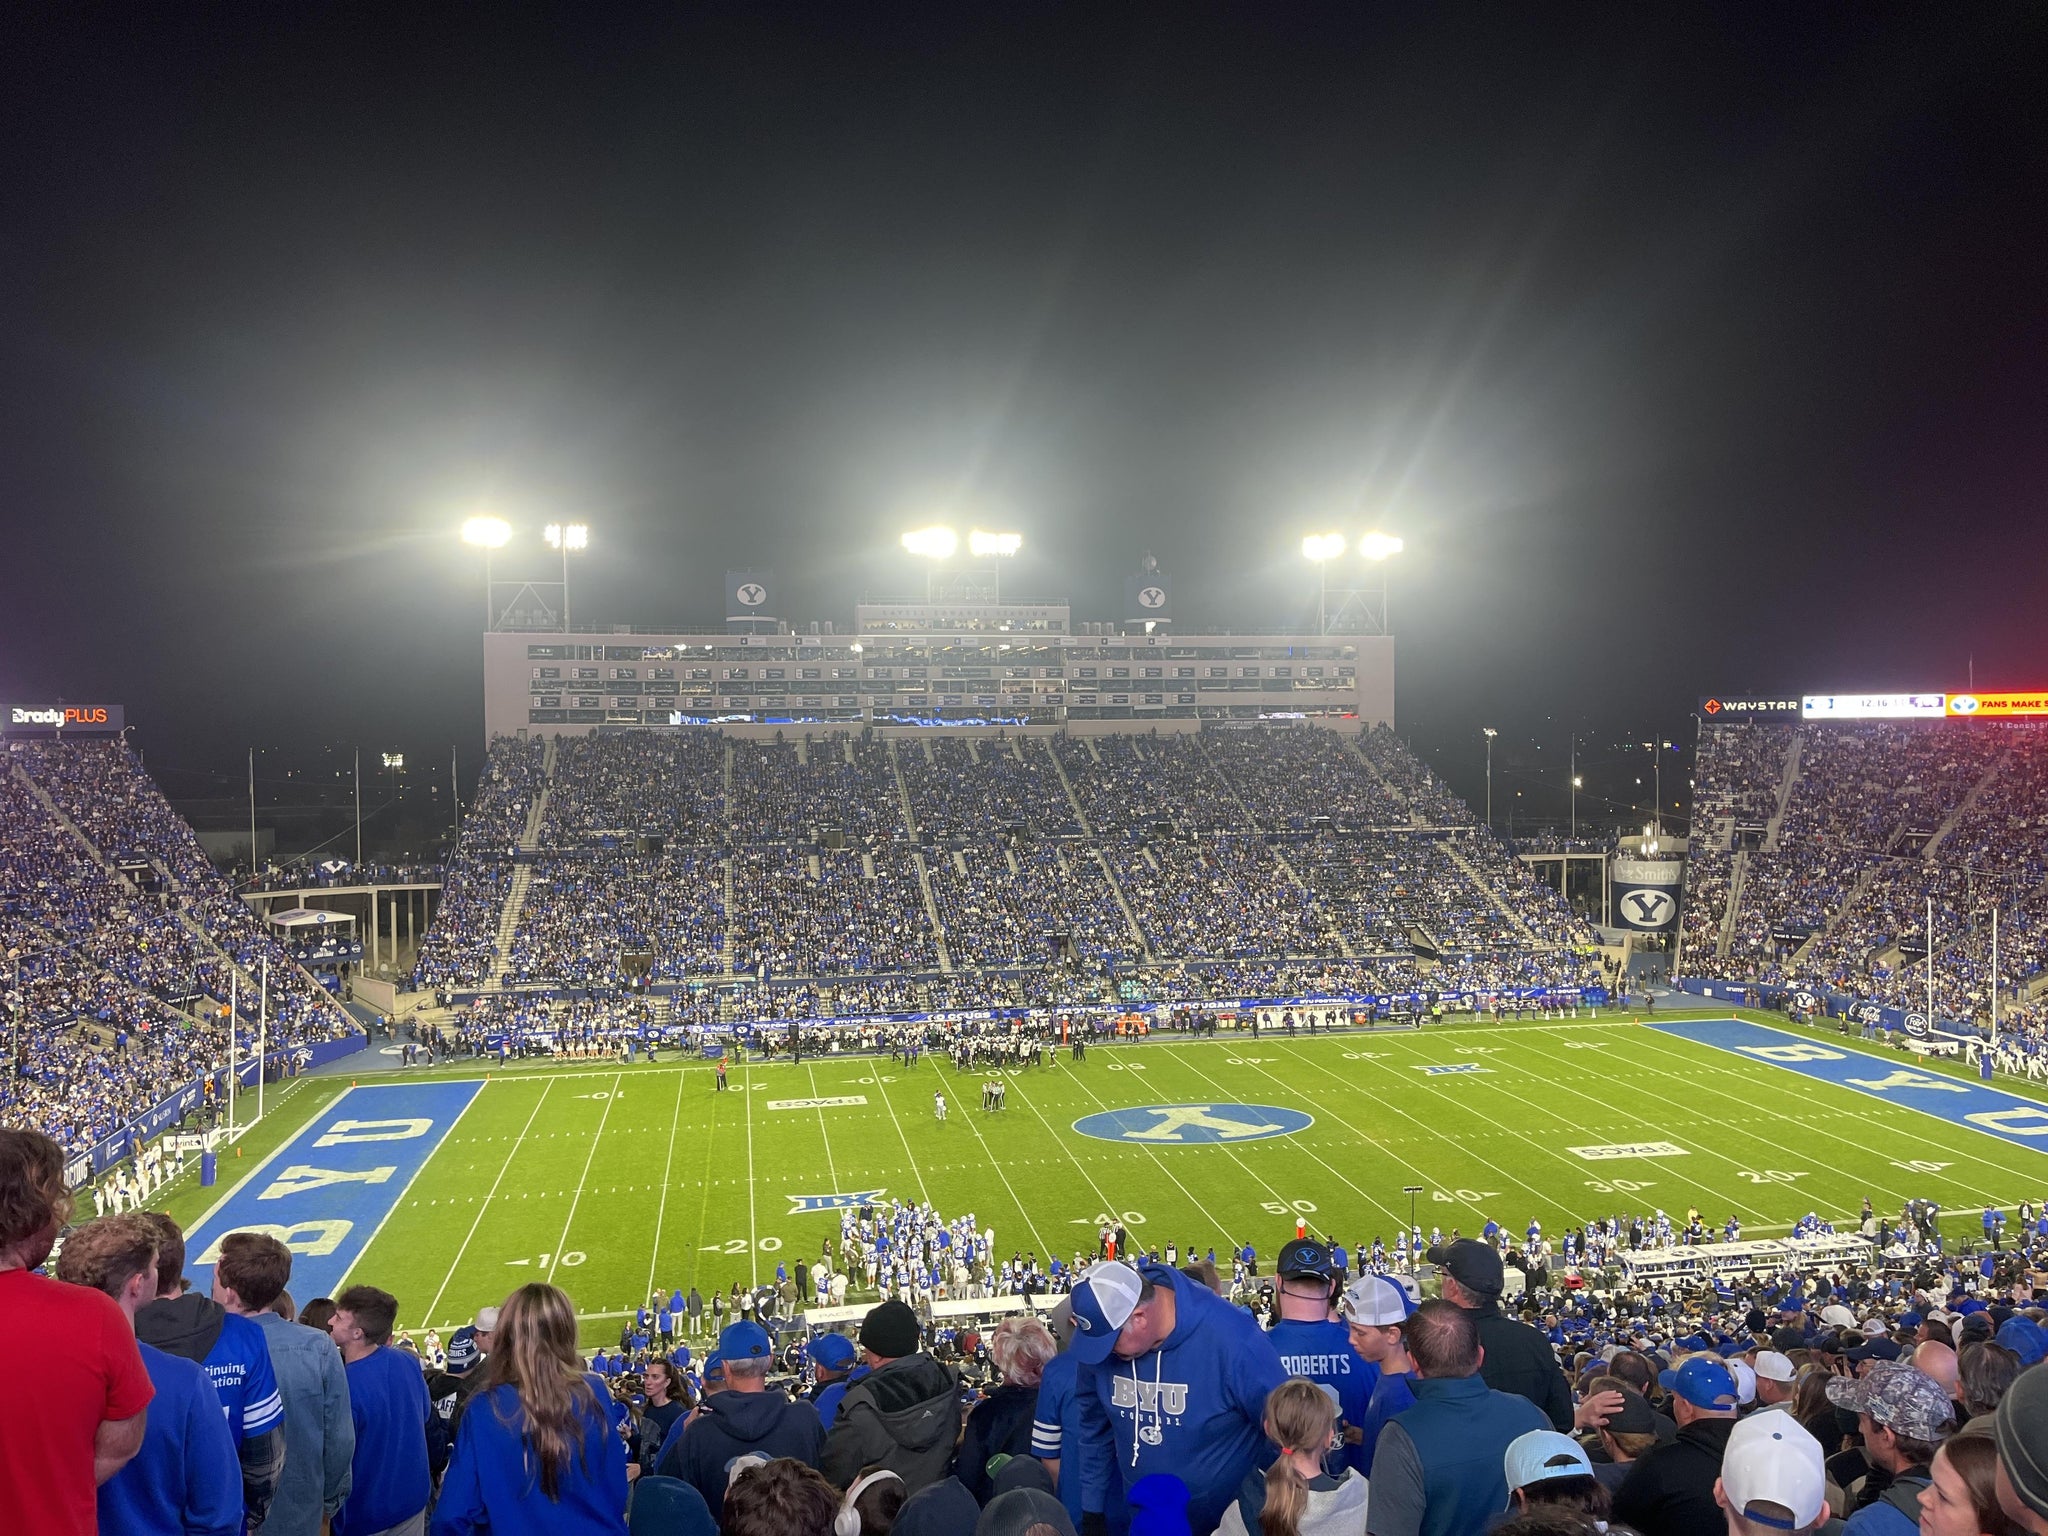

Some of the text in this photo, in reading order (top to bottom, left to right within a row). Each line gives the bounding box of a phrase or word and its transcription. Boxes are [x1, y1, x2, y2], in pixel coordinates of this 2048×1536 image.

[1723, 701, 1798, 711] WAYSTAR
[2011, 700, 2041, 708] MAKE
[12, 708, 107, 728] BradyPLUS
[1635, 865, 1678, 881] Smith's
[1627, 893, 1668, 922] Y
[1341, 1052, 1382, 1060] 30
[1454, 1047, 1494, 1055] 20
[1106, 1063, 1147, 1071] 50
[858, 1076, 898, 1084] 30
[727, 1083, 768, 1092] 20
[591, 1091, 625, 1100] 10
[1122, 1106, 1285, 1141] Y
[1889, 1160, 1942, 1173] 10
[1737, 1170, 1795, 1183] 20
[1584, 1179, 1641, 1193] 30
[1432, 1190, 1483, 1203] 40
[1260, 1200, 1318, 1215] 50
[1093, 1211, 1147, 1225] 40
[724, 1237, 782, 1254] 20
[539, 1251, 587, 1269] 10
[1280, 1354, 1351, 1375] ROBERTS
[1111, 1375, 1188, 1415] BYU
